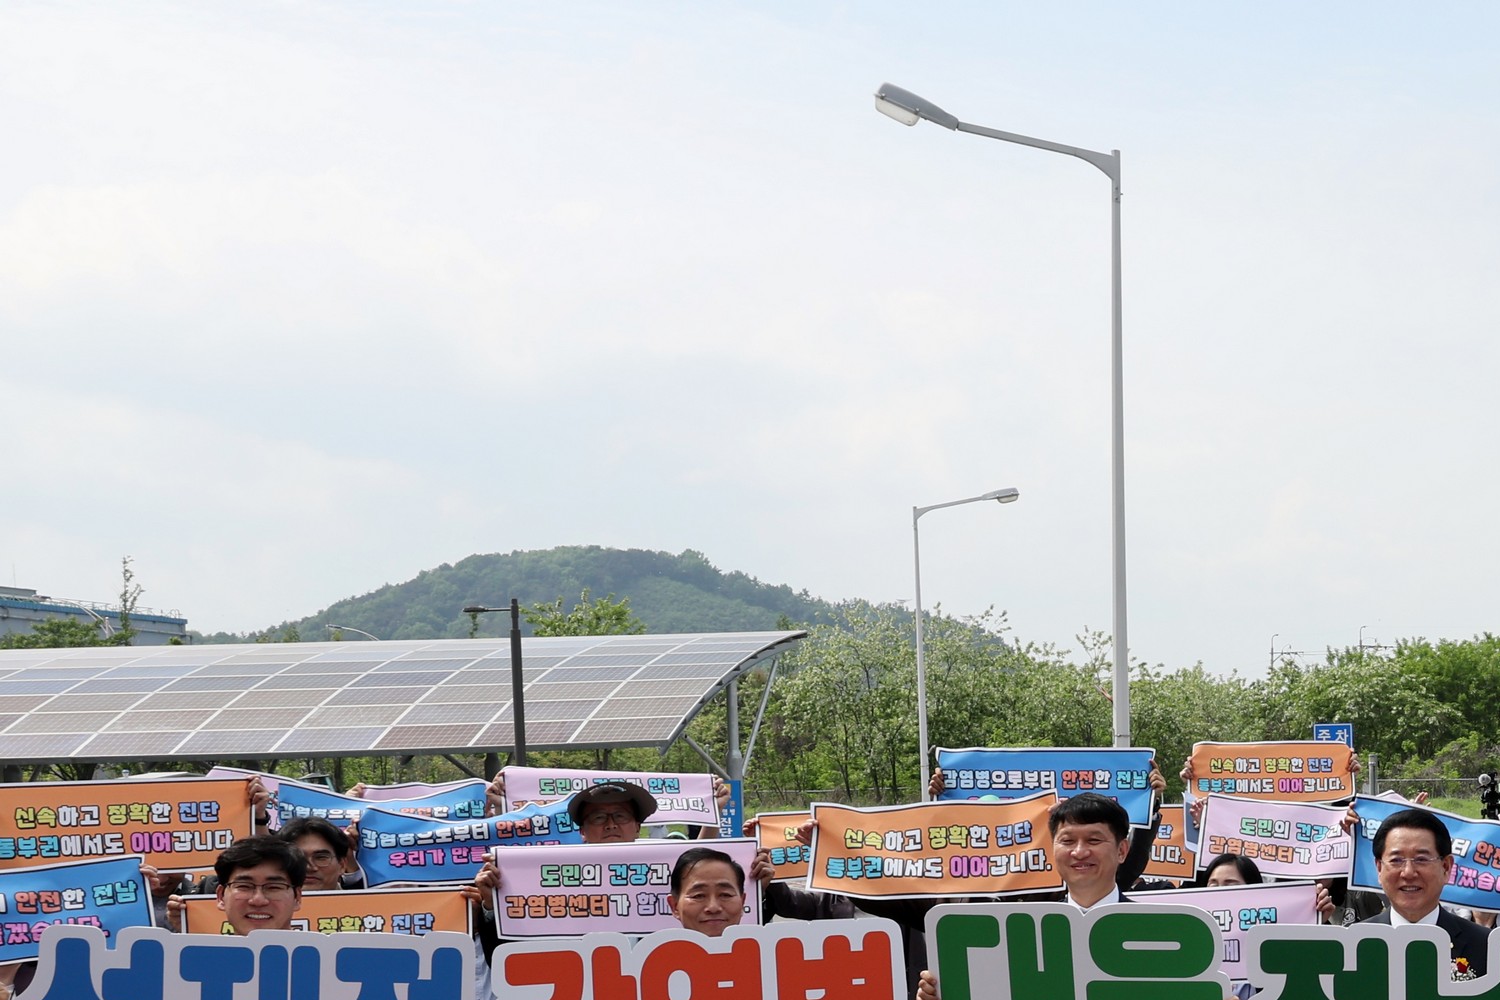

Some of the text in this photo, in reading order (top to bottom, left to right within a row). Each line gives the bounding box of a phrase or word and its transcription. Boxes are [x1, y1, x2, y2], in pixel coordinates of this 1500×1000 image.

[1210, 758, 1333, 773] 신속하고 정확한 진단
[539, 778, 588, 795] 도민의
[648, 778, 680, 794] 안전
[943, 770, 1148, 790] 감염병으로부터 안전한 전남
[1198, 777, 1345, 793] 동부권에서도 이어갑니다.
[15, 801, 220, 829] 신속하고 정확한 진단
[454, 800, 486, 818] 전남
[361, 812, 580, 848] 감염병으로부터 안전한 전
[844, 821, 1032, 852] 신속하고 정확한 진단
[1240, 817, 1291, 840] 도민의
[0, 833, 124, 858] 동부권에서도
[1209, 836, 1349, 864] 감염병센터가 함께
[389, 849, 445, 867] 우리가
[826, 849, 1052, 879] 동부권에서도 이어갑니다.
[540, 864, 671, 887] 도민의 건강과
[15, 889, 85, 914] 안전한
[92, 880, 139, 906] 전남
[505, 894, 630, 918] 감염병센터가
[317, 915, 384, 933] 정확한
[391, 913, 435, 935] 진단
